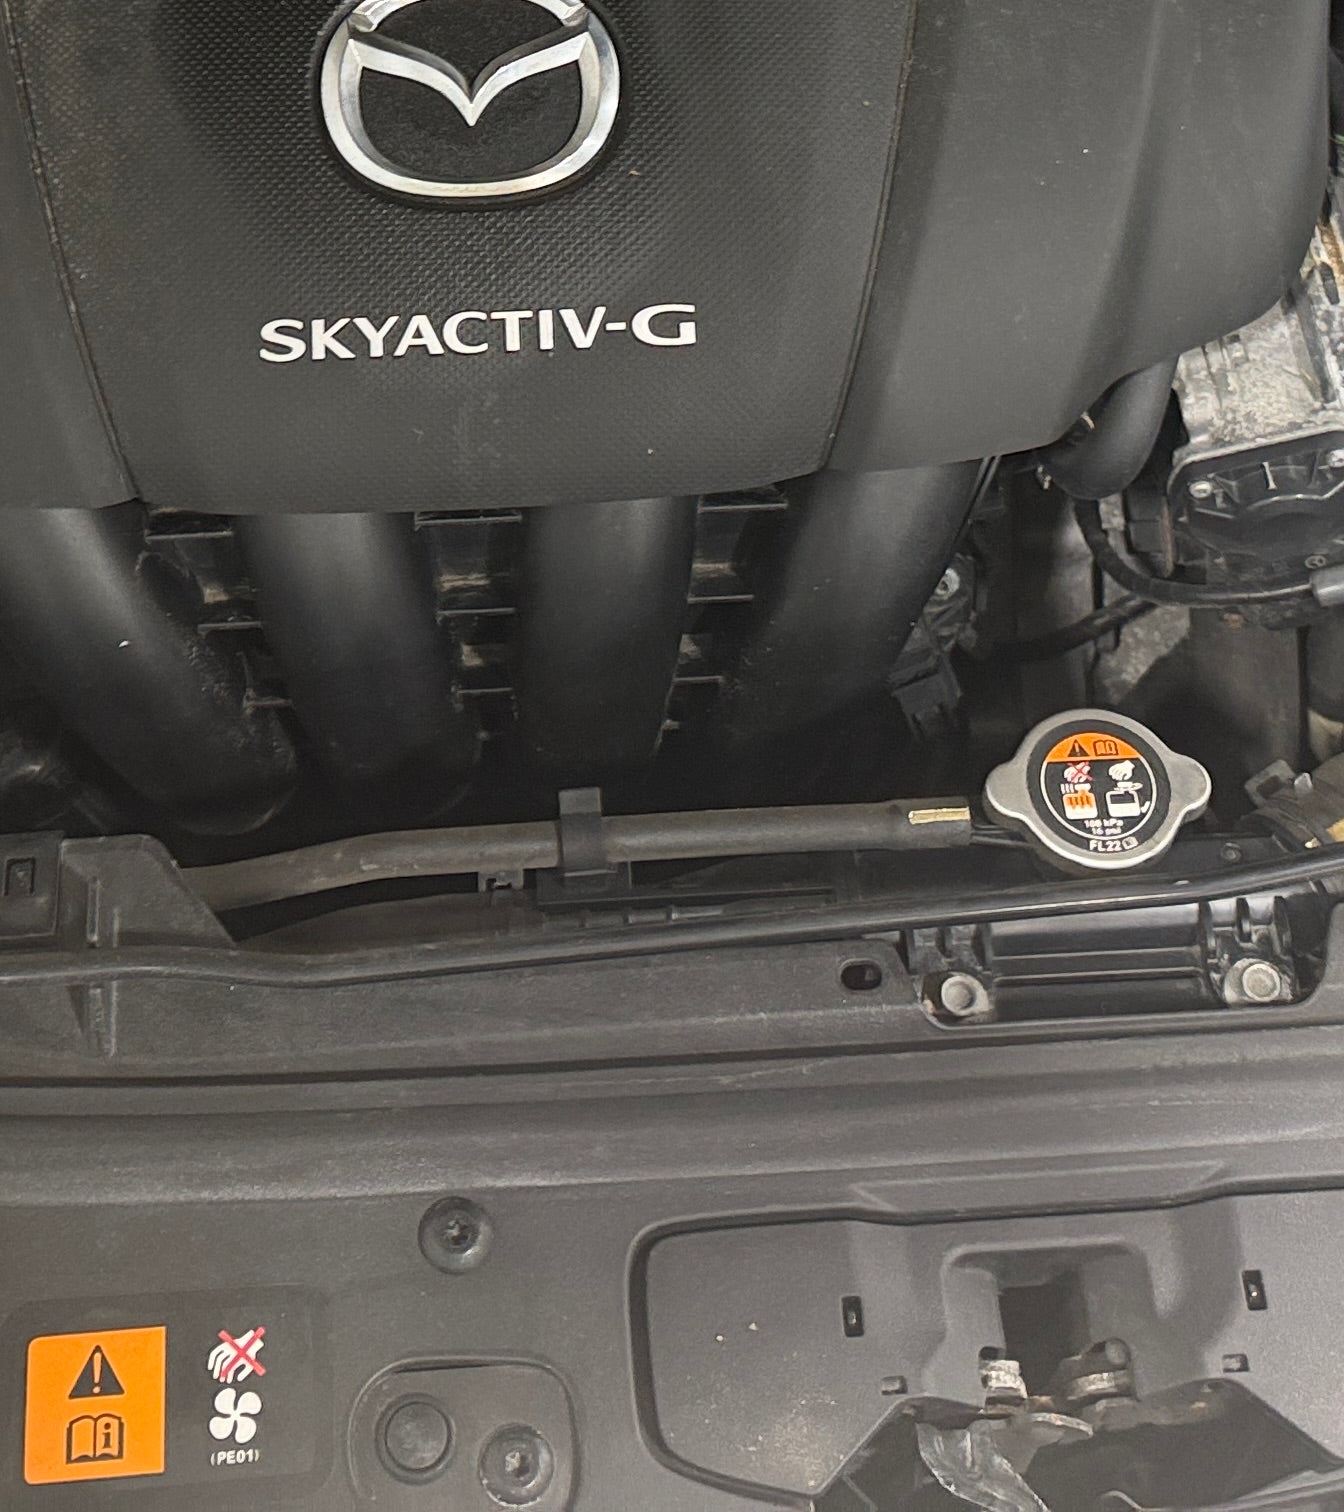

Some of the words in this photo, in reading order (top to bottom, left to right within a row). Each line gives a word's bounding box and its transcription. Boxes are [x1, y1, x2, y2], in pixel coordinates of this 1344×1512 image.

[259, 304, 698, 362] SKYACTIV-G
[1088, 839, 1123, 852] FL22
[210, 1448, 259, 1466] (PE01)
